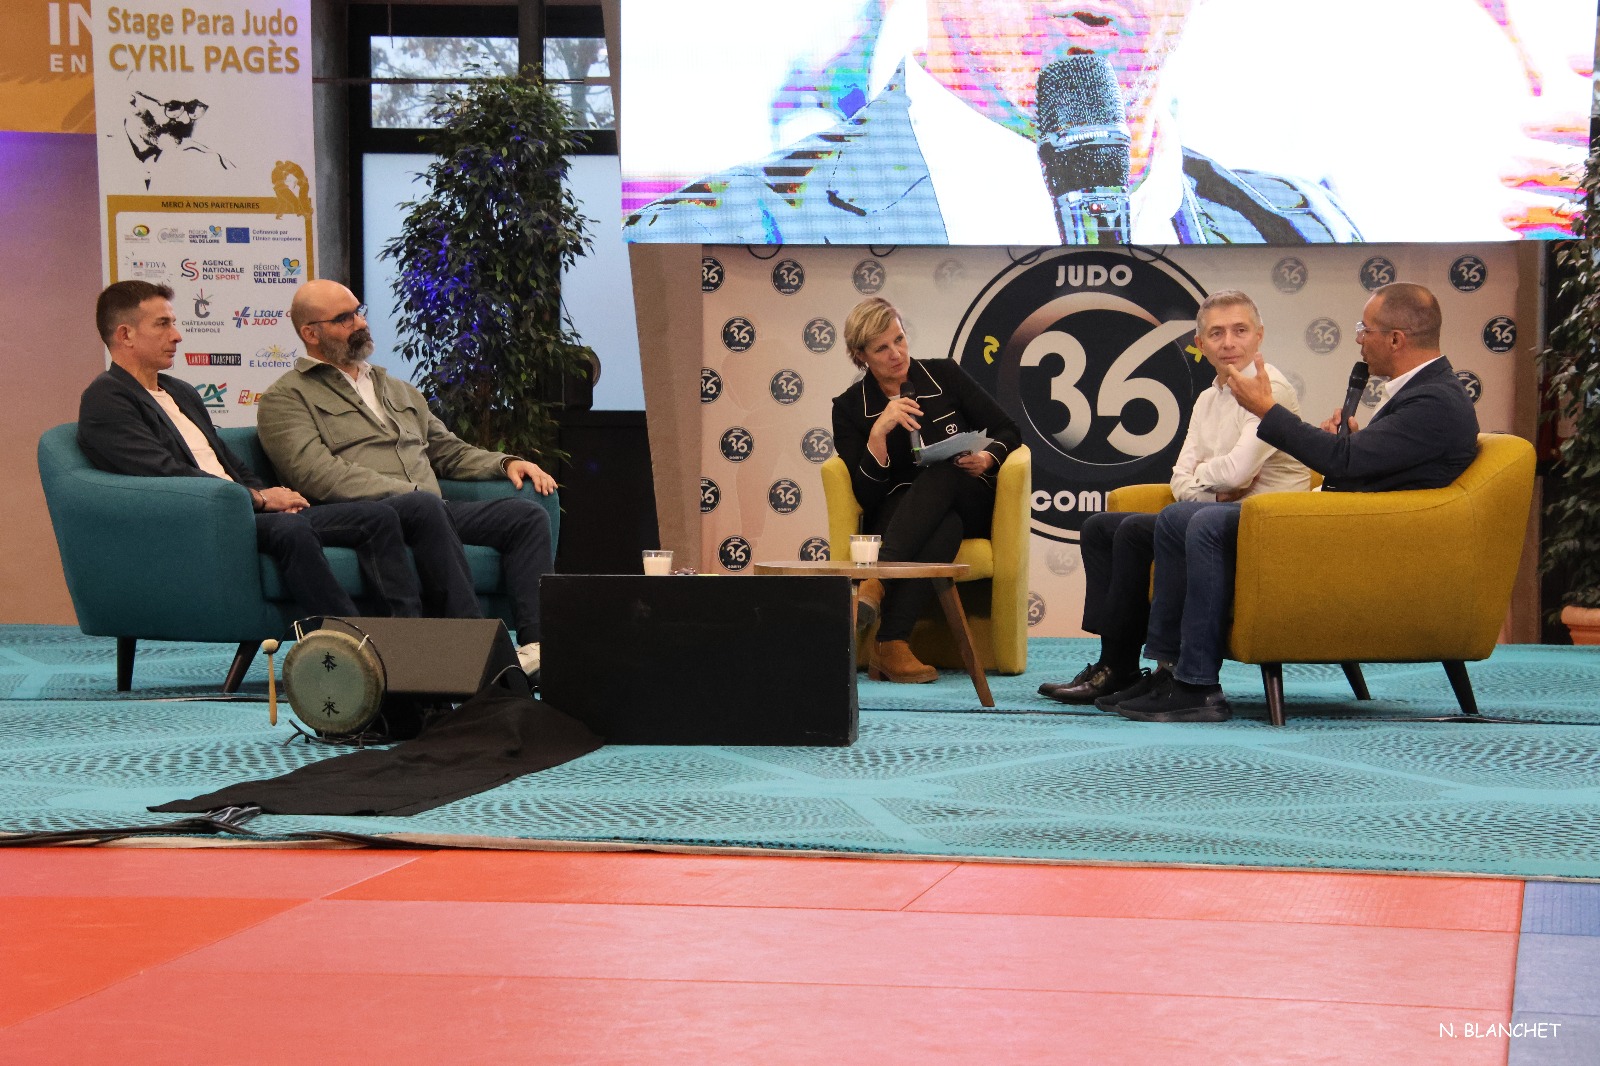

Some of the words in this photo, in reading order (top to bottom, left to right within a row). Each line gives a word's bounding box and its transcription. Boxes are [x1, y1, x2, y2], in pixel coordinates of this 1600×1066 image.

[107, 6, 174, 40] Stage
[182, 8, 235, 35] Para
[242, 8, 298, 36] Judo
[50, 54, 87, 73] EN
[109, 43, 194, 72] CYRIL
[204, 38, 300, 74] PAGÈS
[185, 200, 192, 208] À
[253, 263, 280, 271] RÉGION
[1056, 264, 1133, 287] JUDO
[1281, 265, 1303, 284] 36
[1367, 264, 1393, 283] 36
[1457, 264, 1483, 283] 36
[779, 268, 801, 286] 36
[860, 267, 882, 286] 36
[251, 318, 278, 326] JUDO
[254, 310, 284, 318] LIGUE
[729, 326, 752, 344] 36
[810, 327, 832, 344] 36
[1313, 326, 1337, 345] 36
[1491, 325, 1516, 344] 36
[778, 379, 800, 396] 36
[1020, 319, 1197, 456] 36
[728, 435, 750, 453] 36
[809, 436, 832, 454] 36
[776, 487, 798, 505] 36
[726, 544, 748, 562] 36
